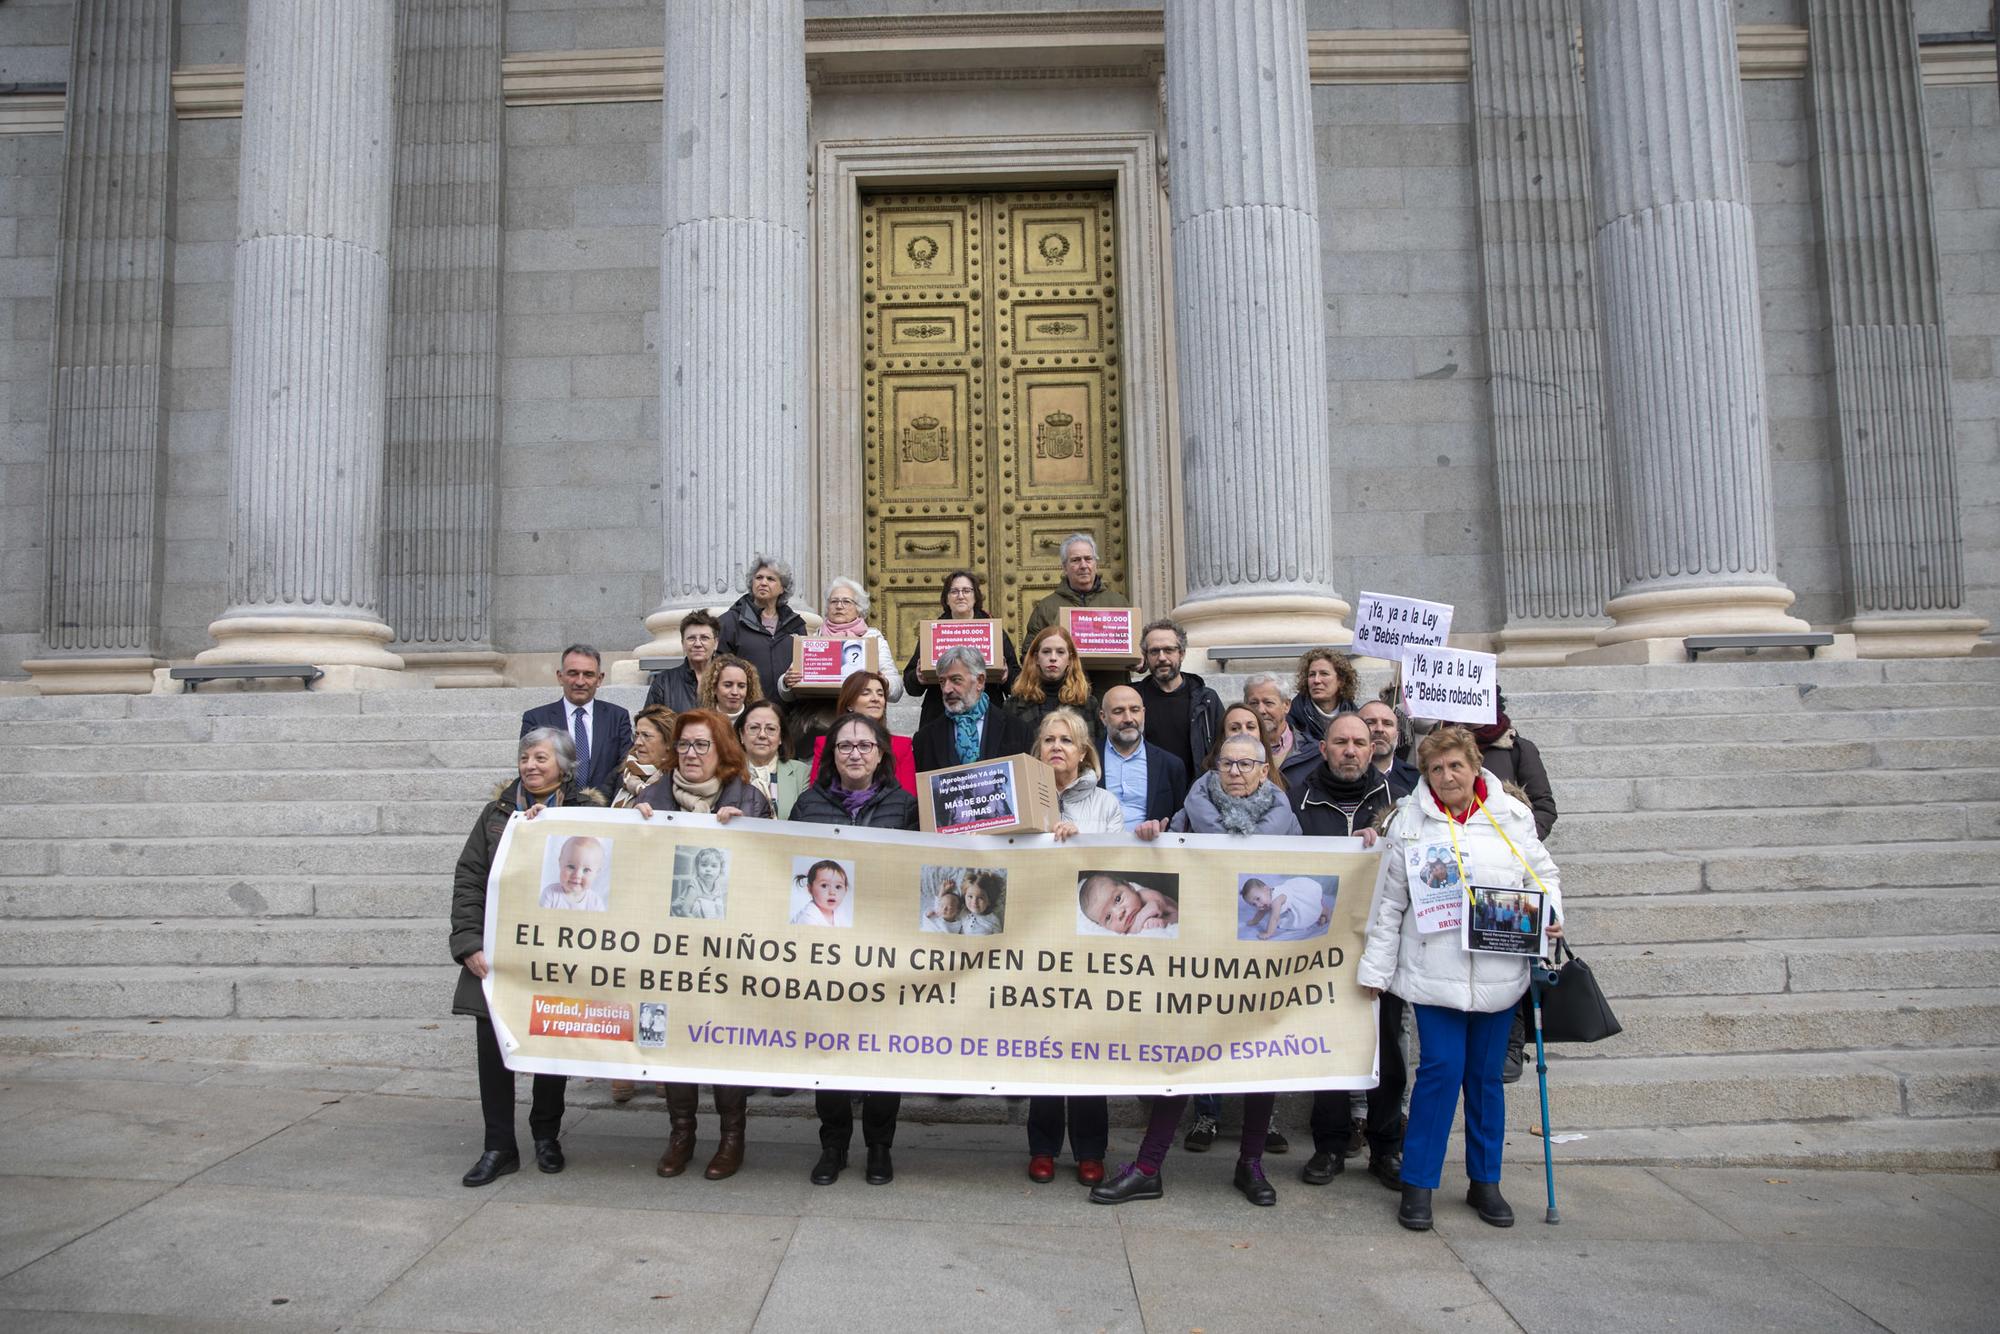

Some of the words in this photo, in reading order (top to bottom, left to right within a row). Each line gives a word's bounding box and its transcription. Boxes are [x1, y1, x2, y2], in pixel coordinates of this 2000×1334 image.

[1368, 601, 1384, 621] ¡Ya,
[1387, 607, 1398, 624] ya
[1402, 609, 1408, 622] a
[1411, 607, 1419, 624] la
[1422, 609, 1438, 631] Ley
[1358, 624, 1369, 640] de
[1372, 626, 1400, 645] "Bebés
[1412, 653, 1427, 676] ¡Ya,
[1432, 660, 1443, 678] ya
[1447, 661, 1453, 675] a
[1457, 658, 1464, 676] la
[1468, 660, 1482, 684] Ley
[1405, 680, 1413, 699] de
[1416, 682, 1447, 702] "Bebés
[1449, 686, 1490, 707] robados"!
[958, 782, 977, 791] bebés
[976, 792, 1006, 804] 80.000
[961, 806, 992, 818] FIRMAS
[517, 924, 544, 946] EL
[559, 927, 639, 952] ROBO
[654, 934, 688, 955] DE
[703, 933, 796, 962] NIÑOS
[811, 943, 840, 965] ES
[856, 946, 895, 968] UN
[910, 949, 1023, 971] CRIMEN
[1039, 951, 1073, 972] DE
[1088, 953, 1154, 976] LESA
[1169, 947, 1343, 979] HUMANIDAD
[532, 961, 577, 983] LEY
[592, 966, 625, 987] DE
[641, 967, 728, 994] BEBÉS
[742, 976, 885, 1002] ROBADOS
[900, 982, 955, 1005] ¡YA!
[535, 999, 582, 1017] Verdad,
[584, 1004, 630, 1020] justicia
[990, 986, 1092, 1009] ¡BASTA
[1107, 990, 1141, 1012] DE
[1157, 982, 1334, 1014] IMPUNIDAD!
[542, 1020, 550, 1032] y
[553, 1020, 620, 1034] reparación
[688, 1025, 797, 1047] VÍCTIMAS
[805, 1031, 849, 1051] POR
[858, 1033, 880, 1053] EL
[889, 1035, 952, 1055] ROBO
[961, 1038, 988, 1056] DE
[997, 1039, 1064, 1059] BEBÉS
[1071, 1042, 1099, 1060] EN
[1108, 1043, 1129, 1060] EL
[1138, 1045, 1222, 1062] ESTADO
[1230, 1036, 1331, 1060] ESPAÑOL
